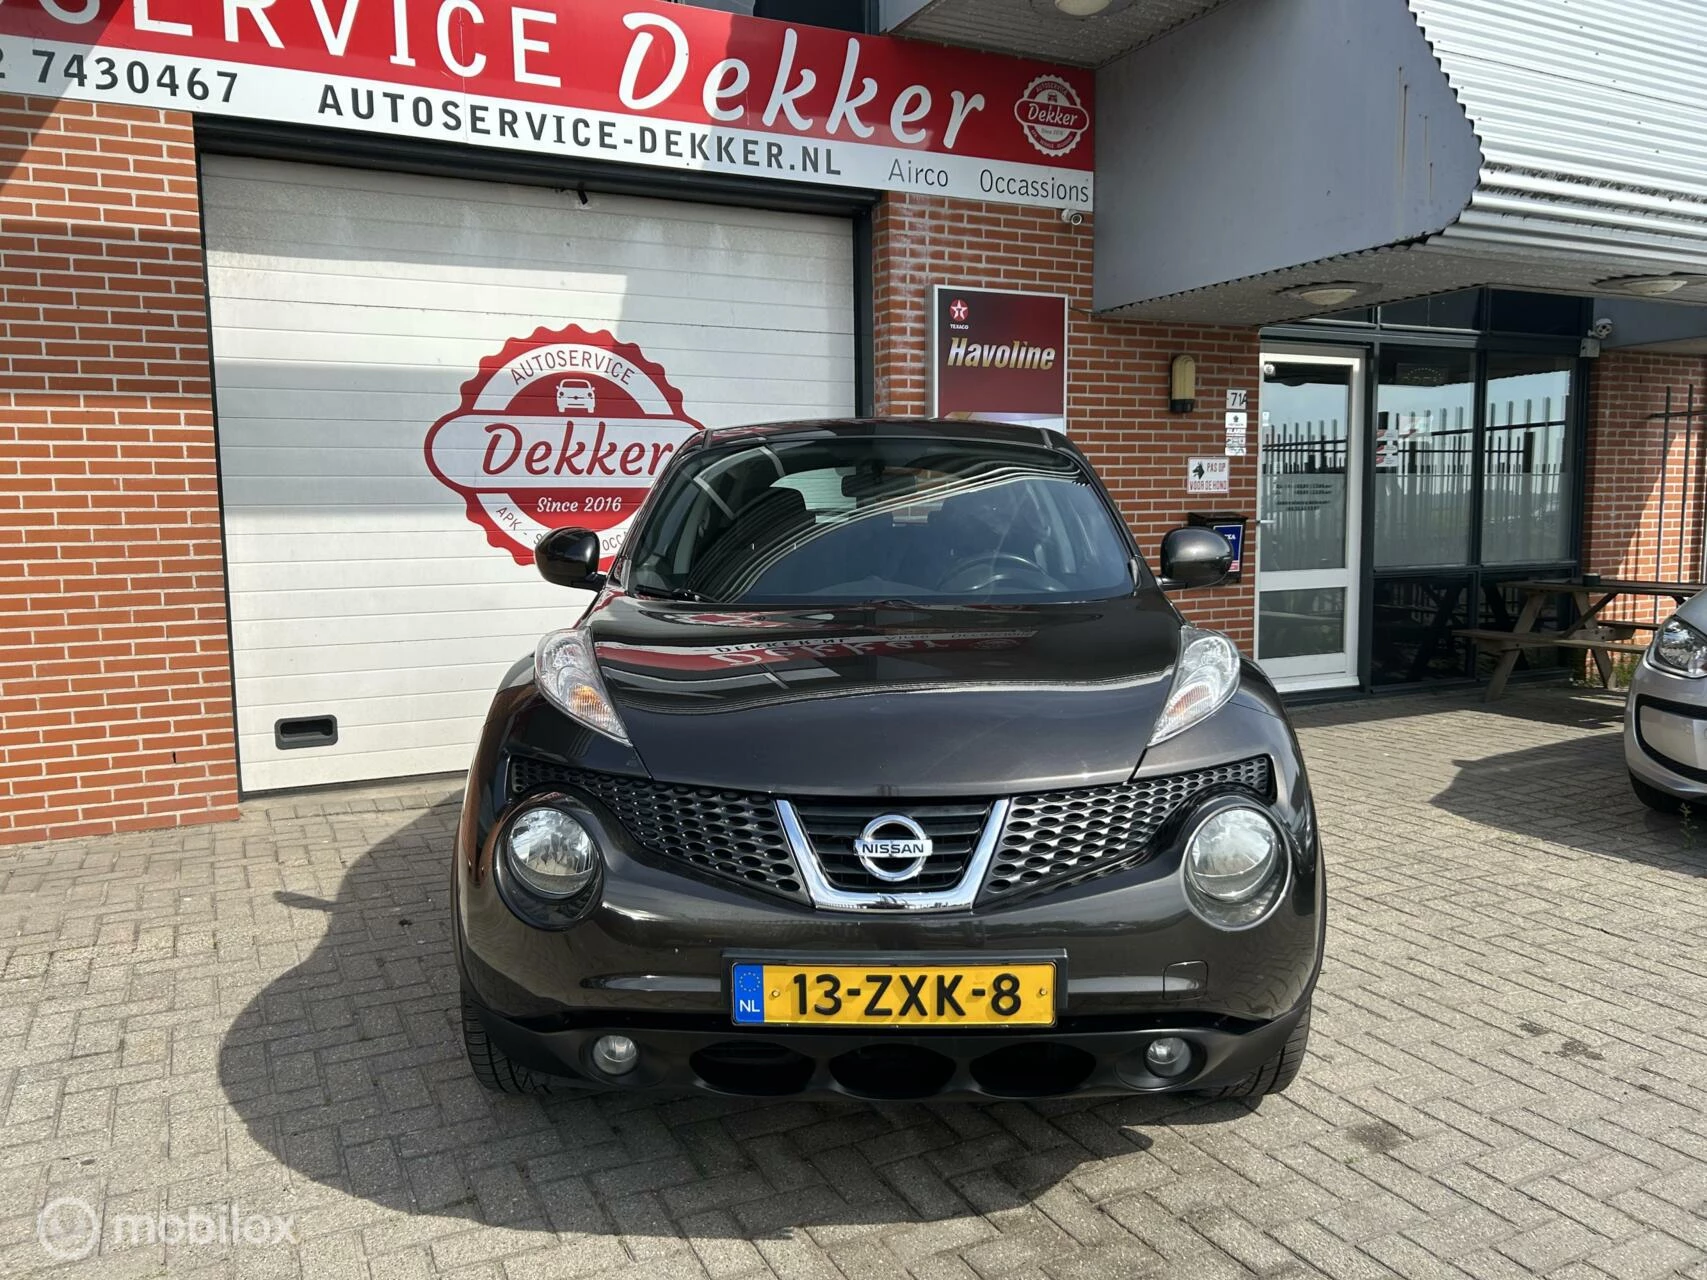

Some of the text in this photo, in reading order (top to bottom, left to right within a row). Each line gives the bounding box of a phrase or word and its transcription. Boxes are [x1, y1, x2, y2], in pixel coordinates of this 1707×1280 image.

[618, 11, 985, 149] Dekker
[32, 48, 239, 104] 7430467
[317, 83, 842, 176] AUTOSERVICE-DEKKER.NL
[888, 158, 949, 188] Airco
[979, 168, 1090, 203] Occassions
[1028, 103, 1078, 126] Dekker
[947, 337, 1056, 370] Havoline
[510, 349, 636, 386] AUTOSERVICE
[482, 420, 674, 476] Dekker
[1206, 462, 1218, 472] PAS
[1190, 480, 1227, 491] VOOR DE HOND
[536, 496, 622, 513] Since 2016
[496, 507, 521, 531] APK
[861, 843, 924, 854] NISSAN
[740, 999, 760, 1013] NL
[793, 973, 1022, 1017] 13-ZXK-8
